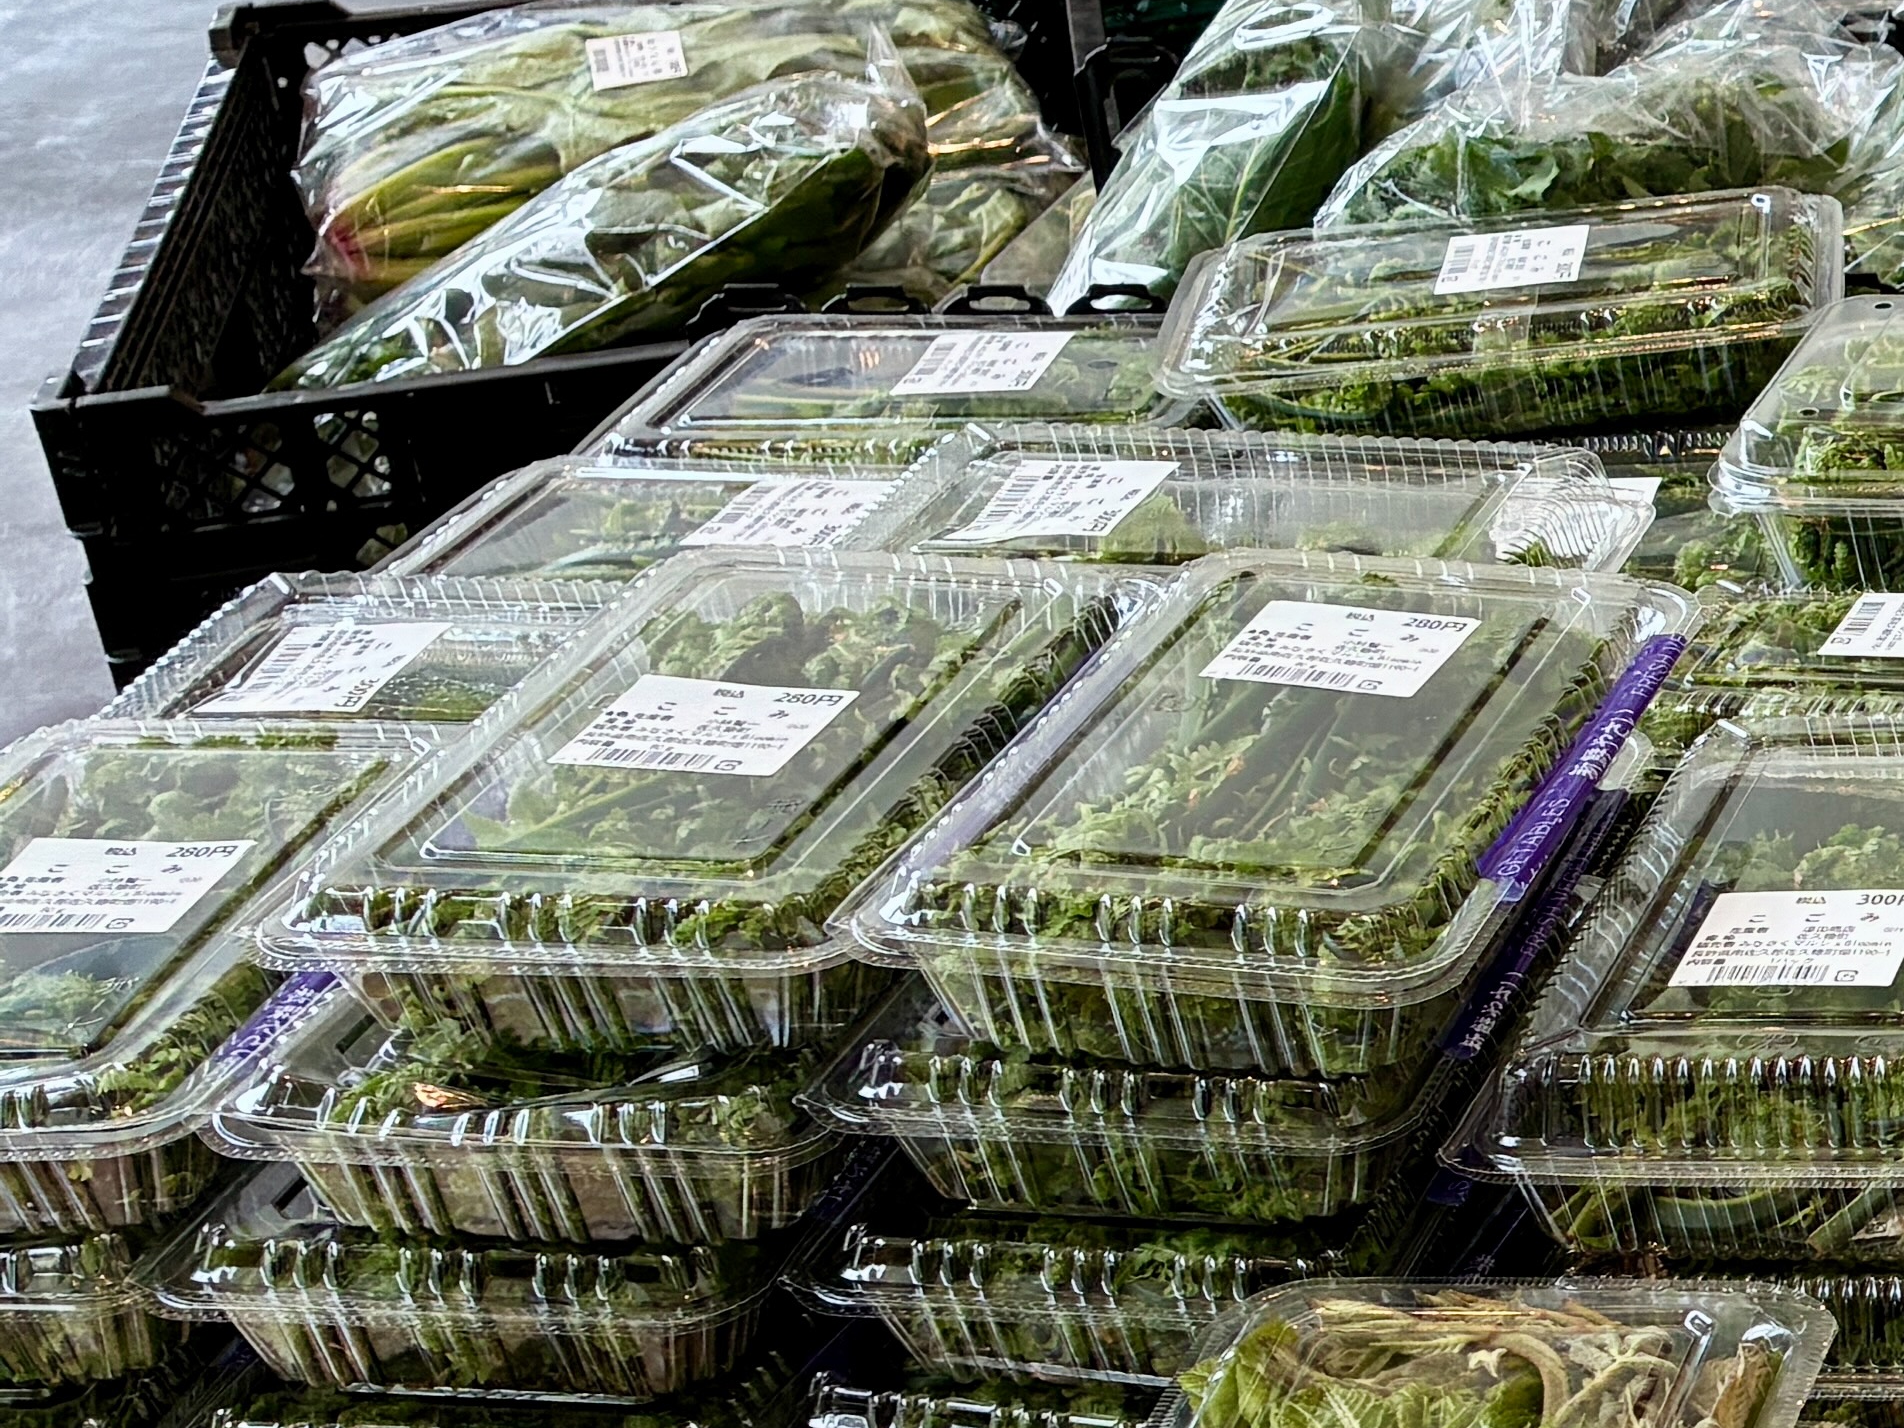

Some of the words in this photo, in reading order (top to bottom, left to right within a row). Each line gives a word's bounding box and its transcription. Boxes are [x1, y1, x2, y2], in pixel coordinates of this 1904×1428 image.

[1403, 617, 1467, 631] 280円
[774, 693, 844, 706] 280円
[166, 846, 238, 857] 280円
